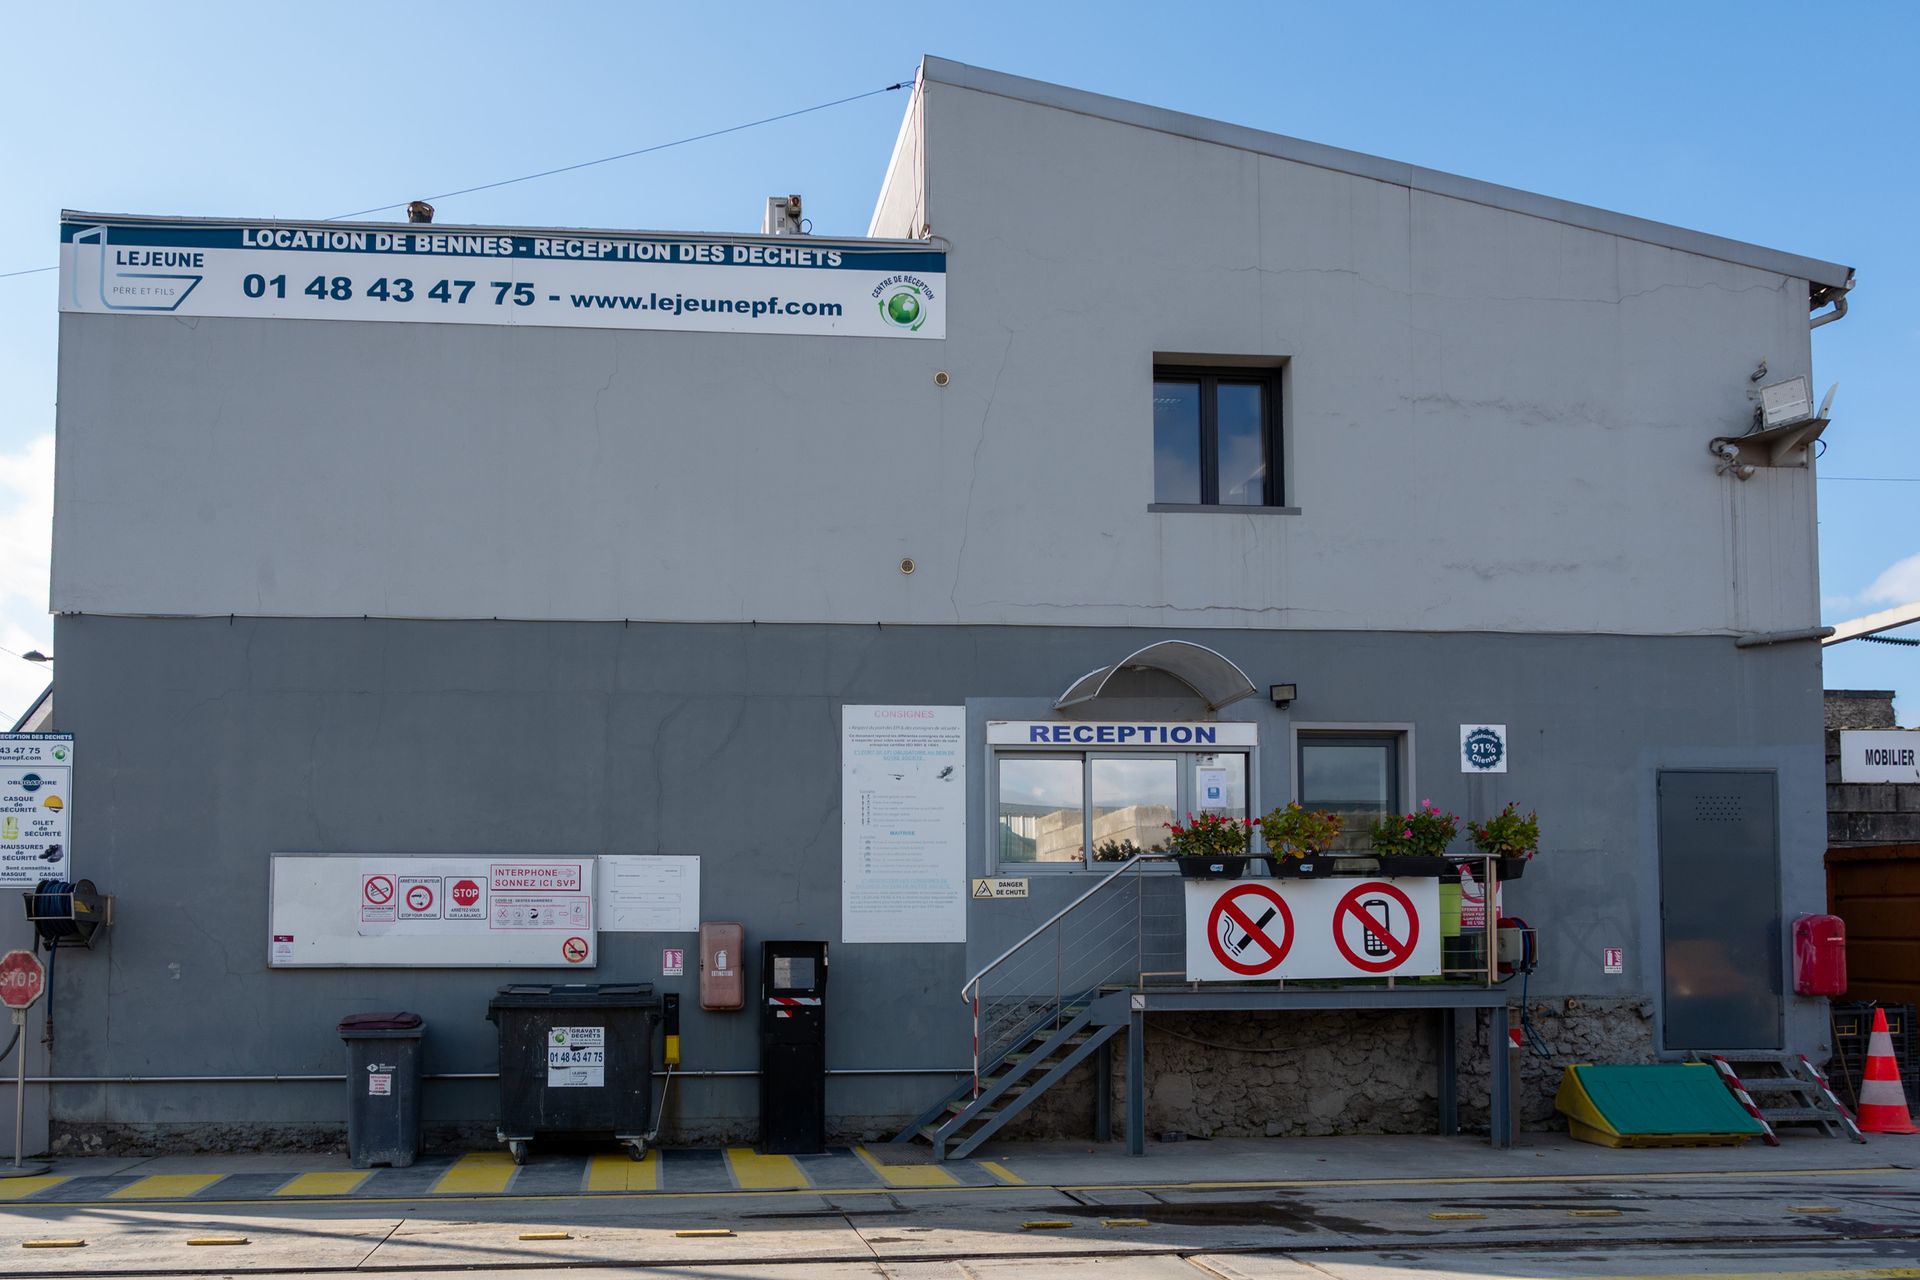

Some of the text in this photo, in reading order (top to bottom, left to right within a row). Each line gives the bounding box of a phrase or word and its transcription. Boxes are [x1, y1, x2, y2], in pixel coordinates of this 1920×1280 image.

[243, 229, 372, 252] LOCATION
[376, 232, 408, 252] DE
[414, 235, 513, 255] BENNES
[534, 240, 671, 262] RECEPTION
[684, 244, 725, 263] DES
[732, 246, 842, 267] DECHETS
[116, 250, 204, 268] LEJEUNE
[113, 284, 175, 297] PÈRE ET FILS
[871, 277, 893, 298] CENTRE
[893, 275, 902, 283] DE
[243, 273, 287, 298] 01
[305, 276, 353, 301] 48
[366, 278, 415, 303] 43
[428, 279, 476, 304] 47
[490, 281, 536, 307] 75
[570, 291, 843, 318] www.lejeunepf.com
[874, 710, 935, 719] CONSIGNES
[1030, 725, 1216, 743] RECEPTION
[1471, 743, 1497, 754] 91%
[1472, 754, 1497, 764] Clients
[1865, 749, 1915, 767] MOBILIER
[495, 869, 558, 877] INTERPHONE
[495, 879, 536, 887] SONNEZ
[454, 888, 479, 898] STOP
[0, 971, 37, 987] STOP
[550, 1052, 603, 1063] 01 48 43 47 75
